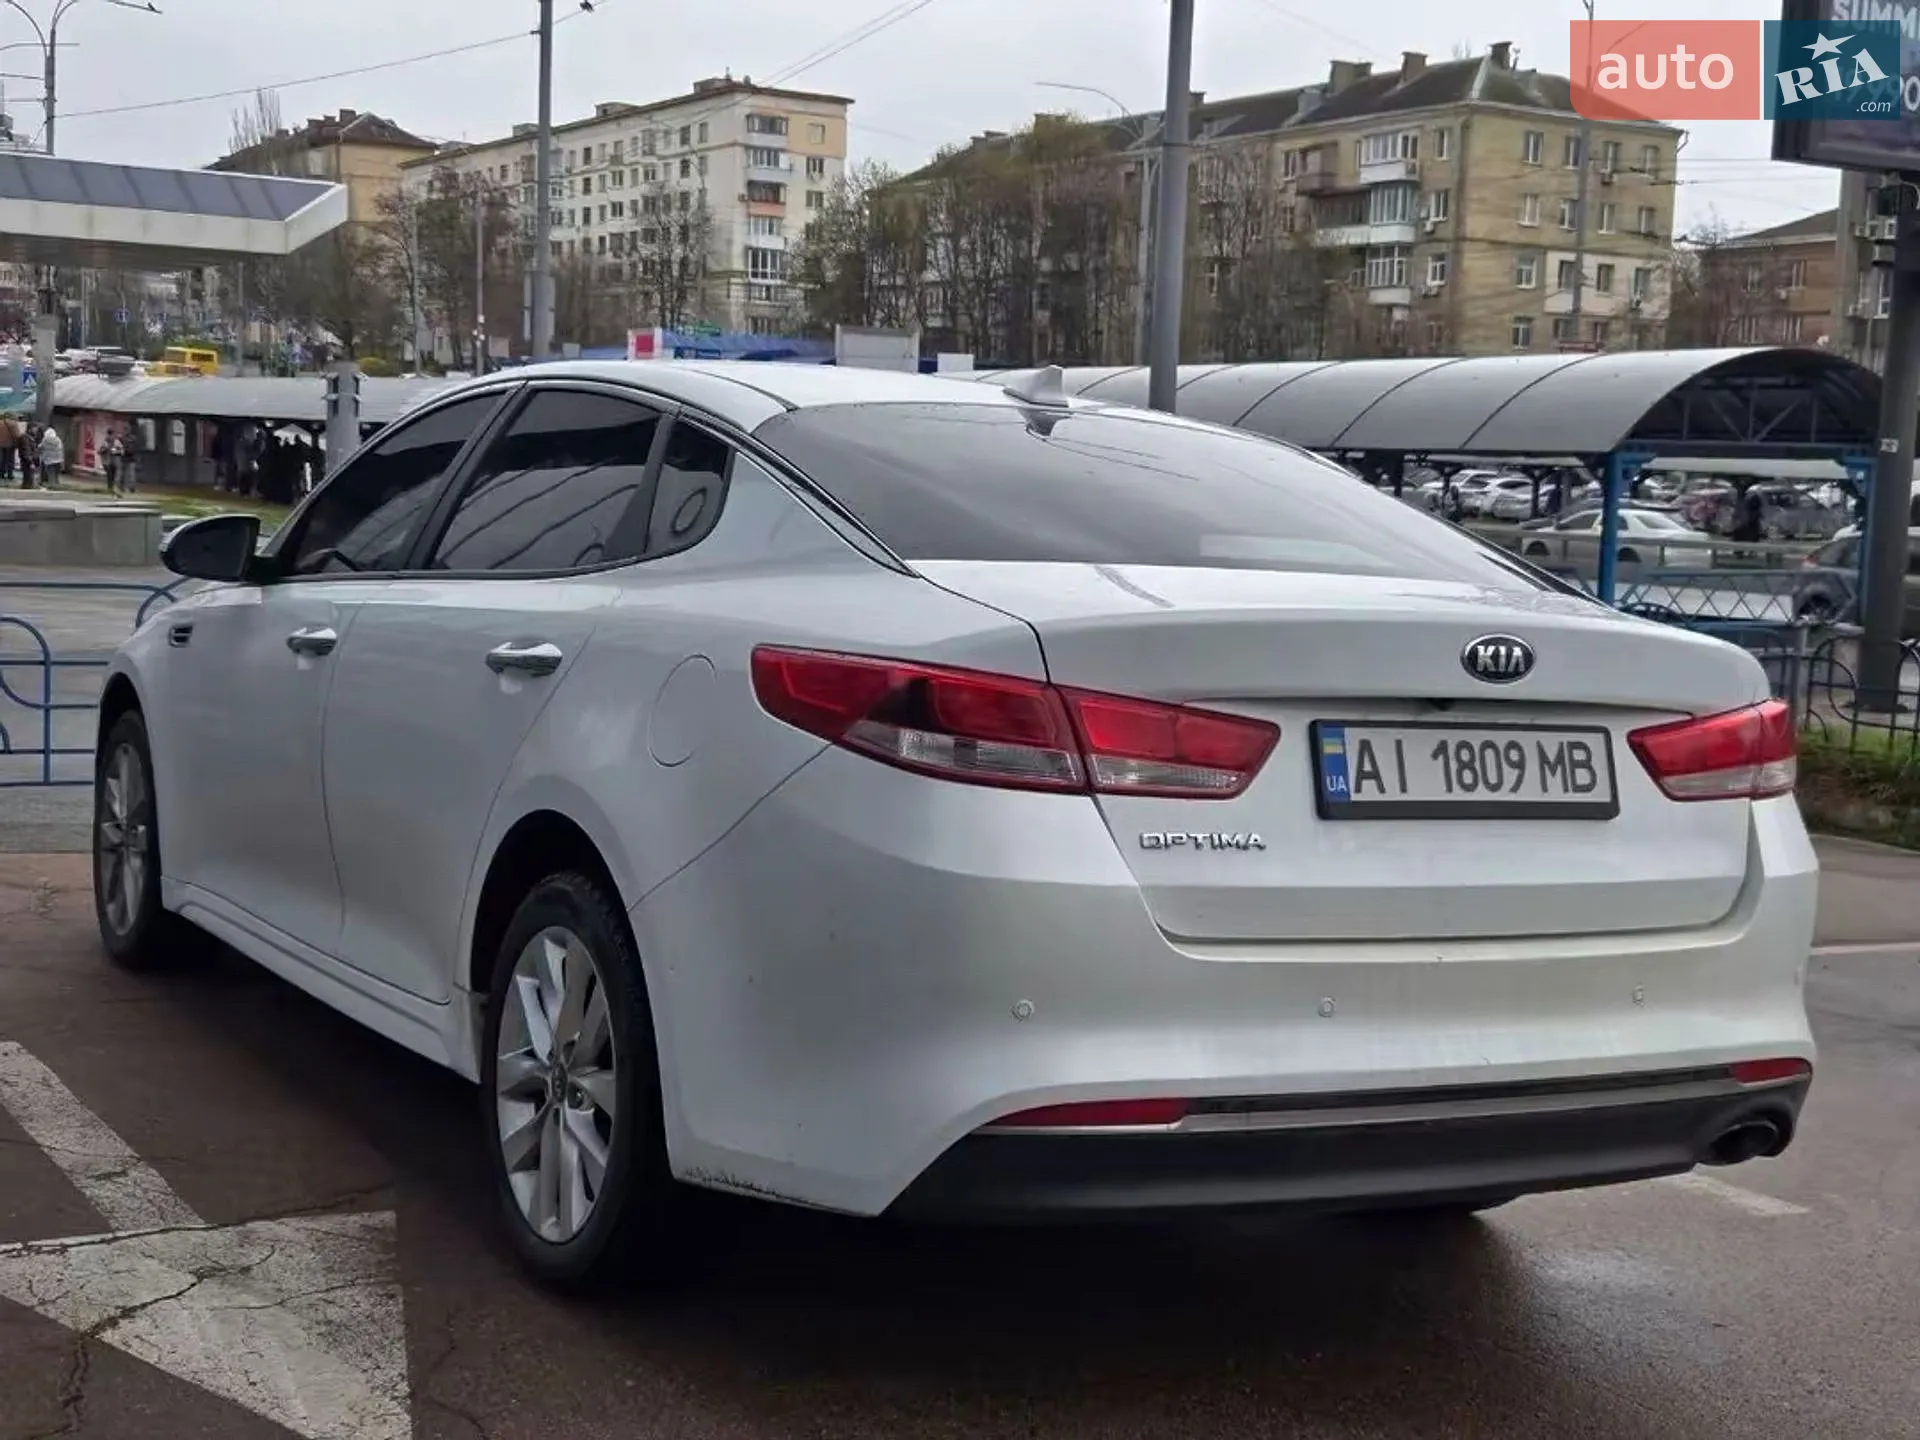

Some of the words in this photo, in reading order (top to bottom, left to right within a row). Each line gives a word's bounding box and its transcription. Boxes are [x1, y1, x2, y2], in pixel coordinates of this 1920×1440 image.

[1831, 0, 1920, 39] SUMM
[1476, 645, 1525, 673] KIA
[1354, 739, 1408, 794] AI
[1431, 739, 1527, 794] 1809
[1536, 740, 1598, 794] MB
[1326, 775, 1348, 792] UA
[1140, 831, 1267, 851] OPTIMA
